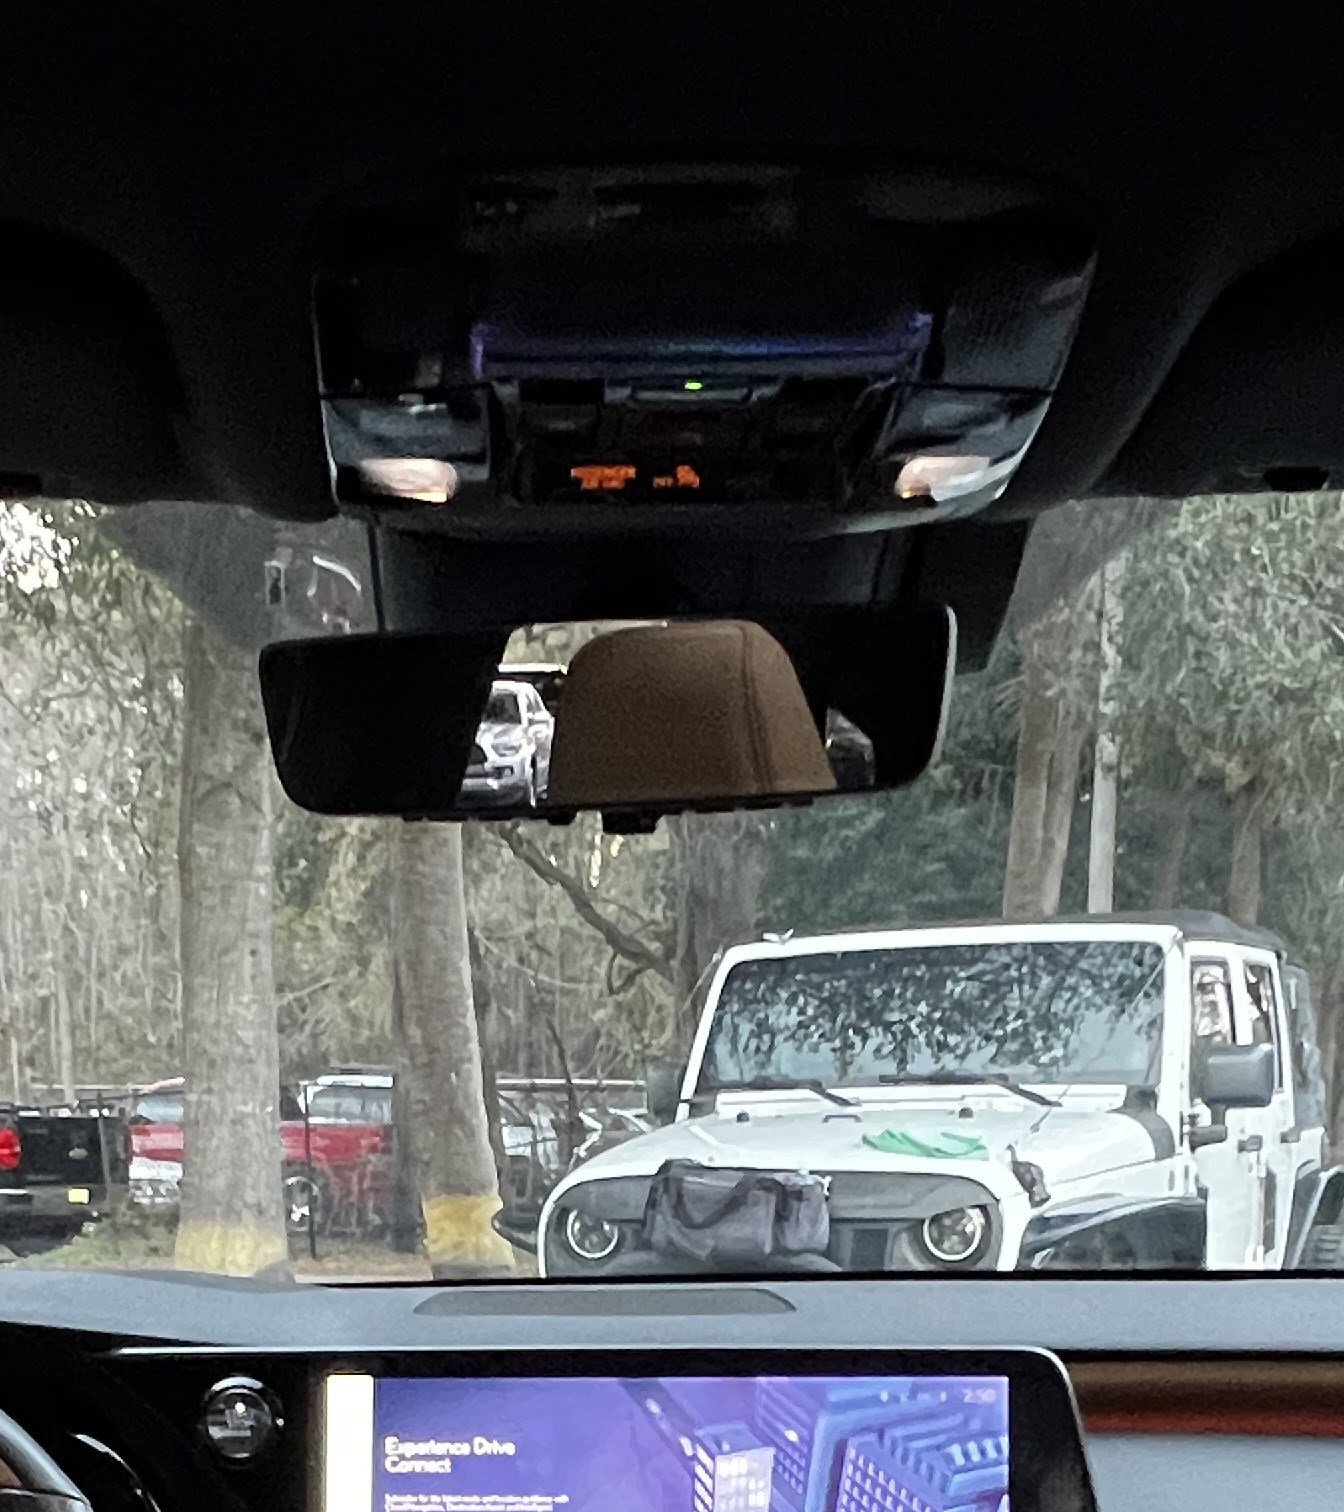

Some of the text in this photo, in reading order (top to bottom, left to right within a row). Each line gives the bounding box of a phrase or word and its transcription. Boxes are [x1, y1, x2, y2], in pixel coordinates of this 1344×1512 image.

[384, 1436, 516, 1458] Experience Drive
[384, 1456, 452, 1474] Connect
